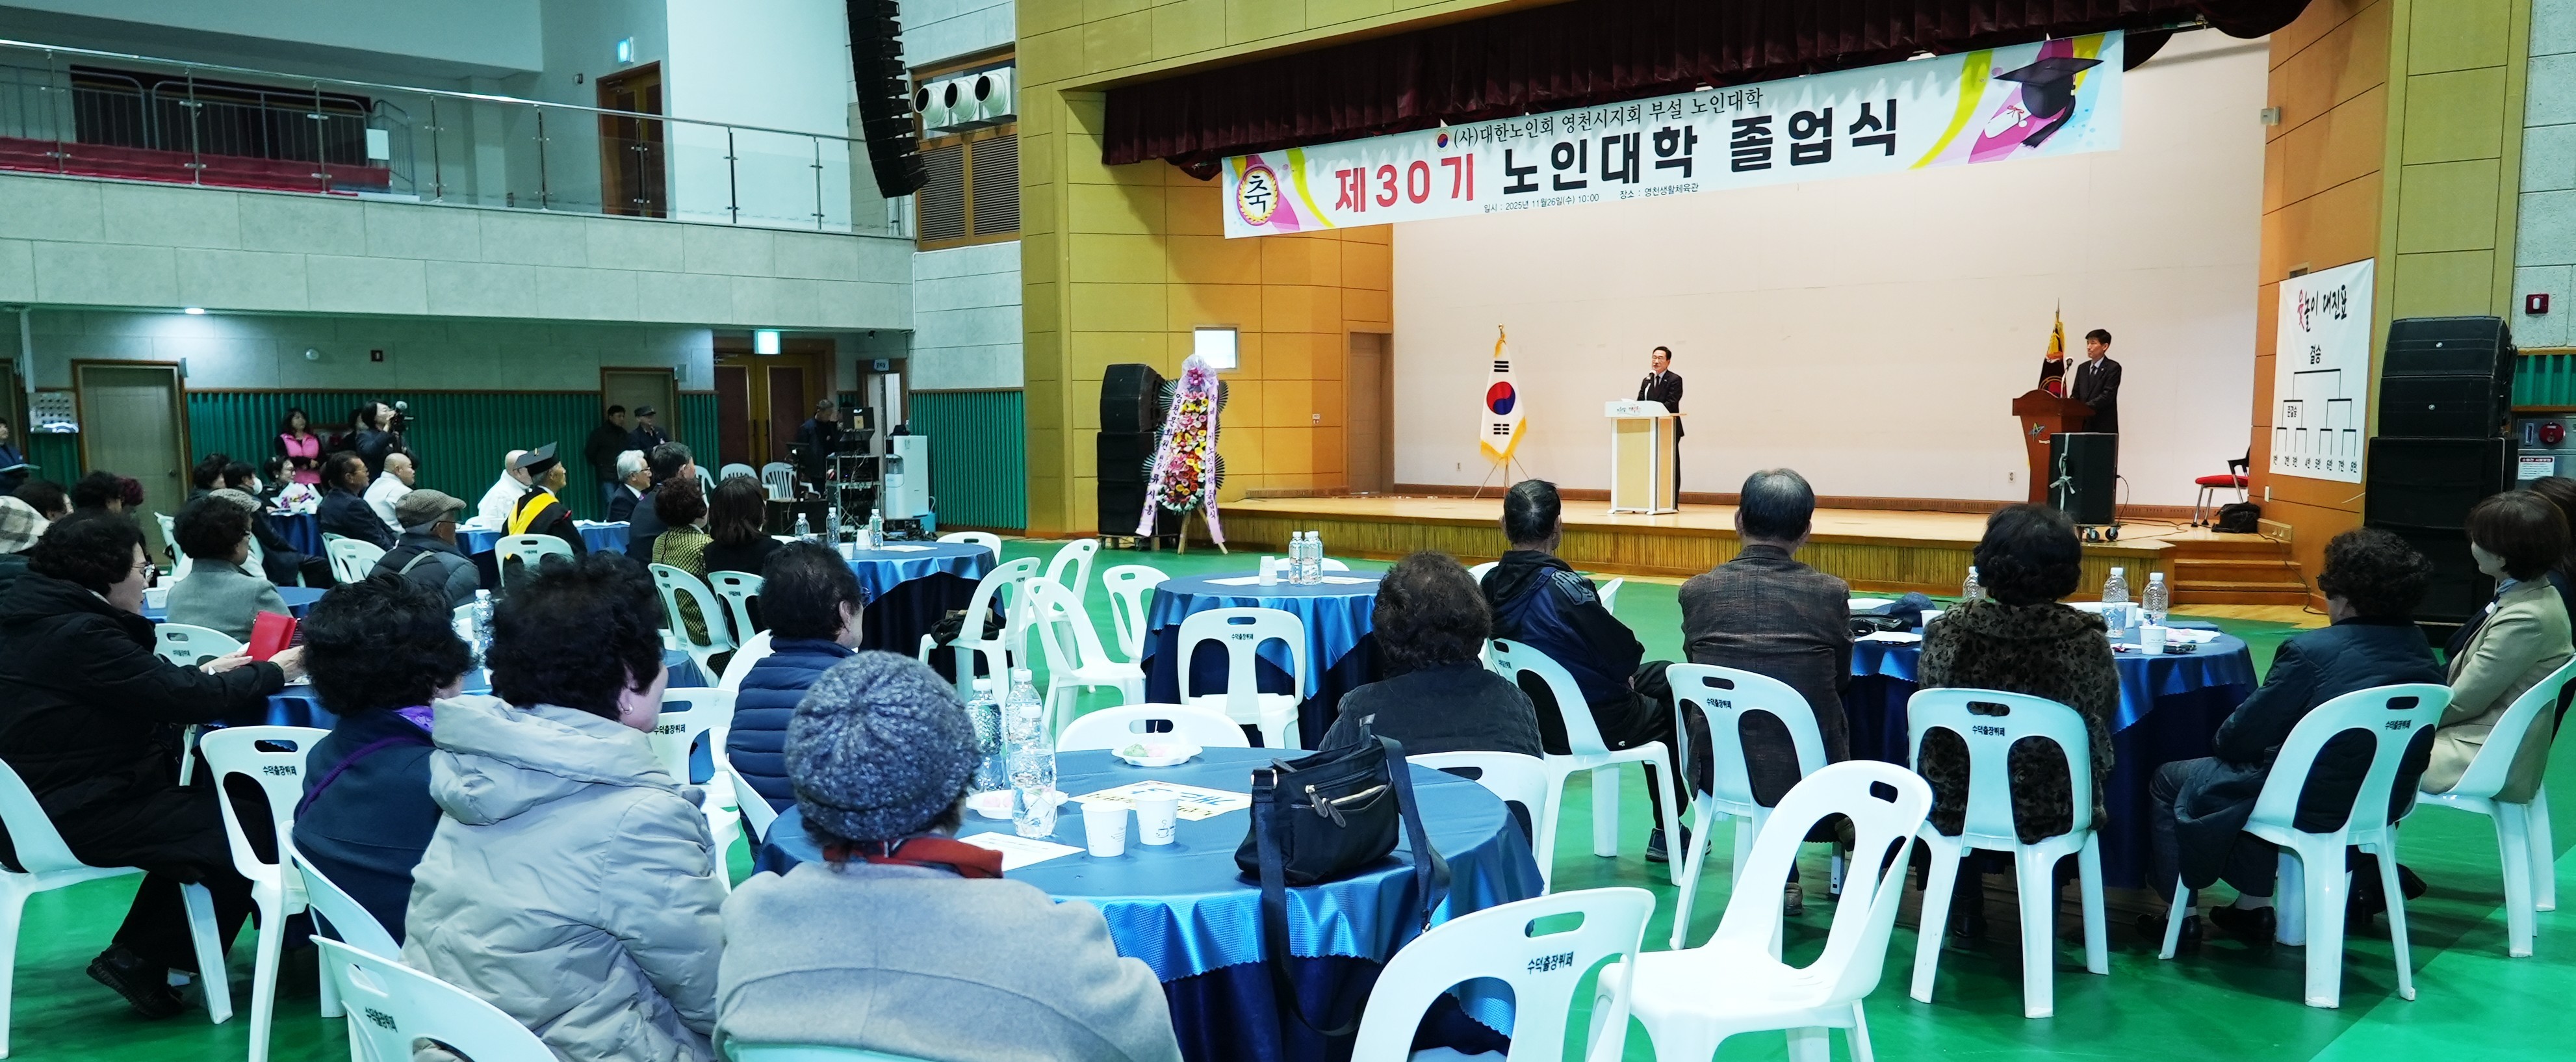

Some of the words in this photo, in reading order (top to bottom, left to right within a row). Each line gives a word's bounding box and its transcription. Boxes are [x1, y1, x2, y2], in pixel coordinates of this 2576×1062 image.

[1453, 117, 1554, 149] (사)대한노인회
[1562, 104, 1642, 134] 영천시지회
[1649, 98, 1682, 122] 부설
[1690, 87, 1764, 115] 노인대학
[1335, 152, 1475, 213] 제30기
[1502, 125, 1698, 195] 노인대학
[1730, 98, 1898, 173] 졸업식
[1244, 174, 1272, 214] 축
[1620, 189, 1634, 200] 장소
[1644, 183, 1699, 198] 영천생활체육관
[1484, 203, 1498, 213] 일시
[1505, 200, 1528, 211] 2025년
[1532, 196, 1575, 208] 11월26일(수)
[1578, 194, 1599, 203] 10:00
[2310, 344, 2321, 365] 결승
[1972, 725, 2005, 736] 수덕출장뷔페
[263, 766, 297, 775] 수덕출장뷔페
[1527, 951, 1574, 974] 수덕출장뷔페
